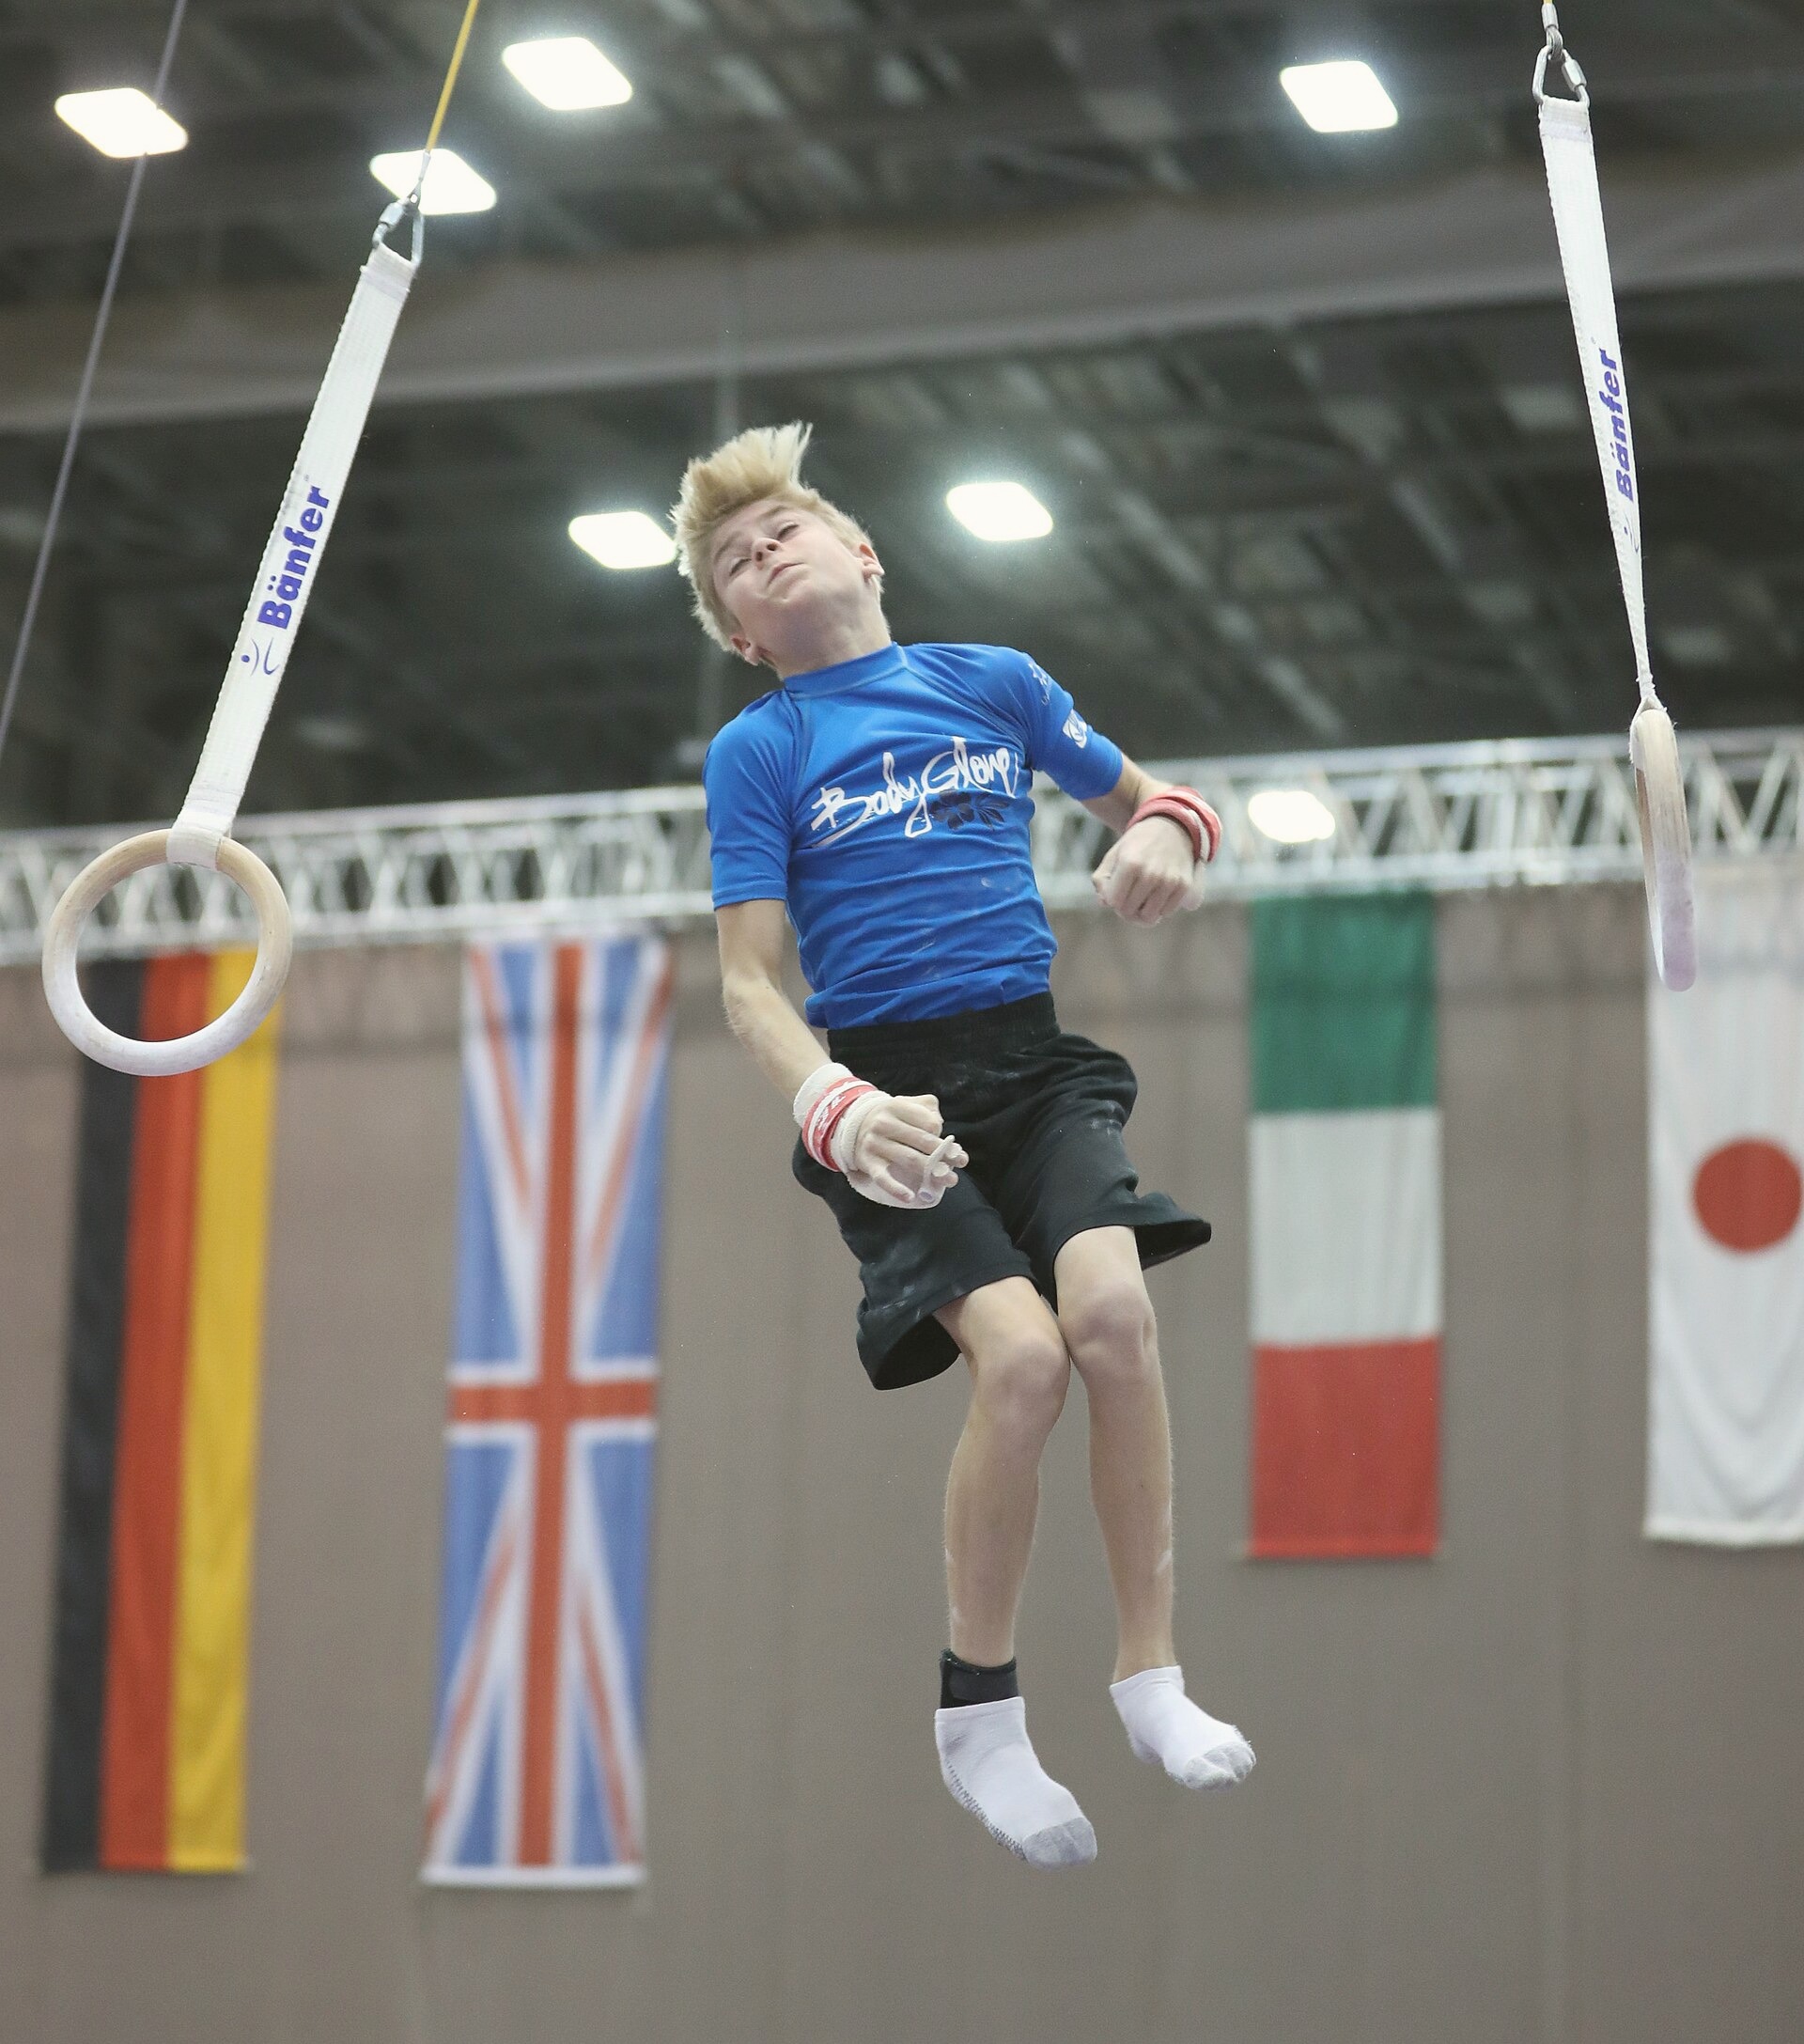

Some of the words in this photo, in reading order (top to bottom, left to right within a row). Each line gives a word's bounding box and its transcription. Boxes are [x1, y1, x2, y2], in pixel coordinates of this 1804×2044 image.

[1599, 348, 1634, 502] Bänfer
[257, 485, 330, 630] Bänfer
[810, 751, 932, 849] Body
